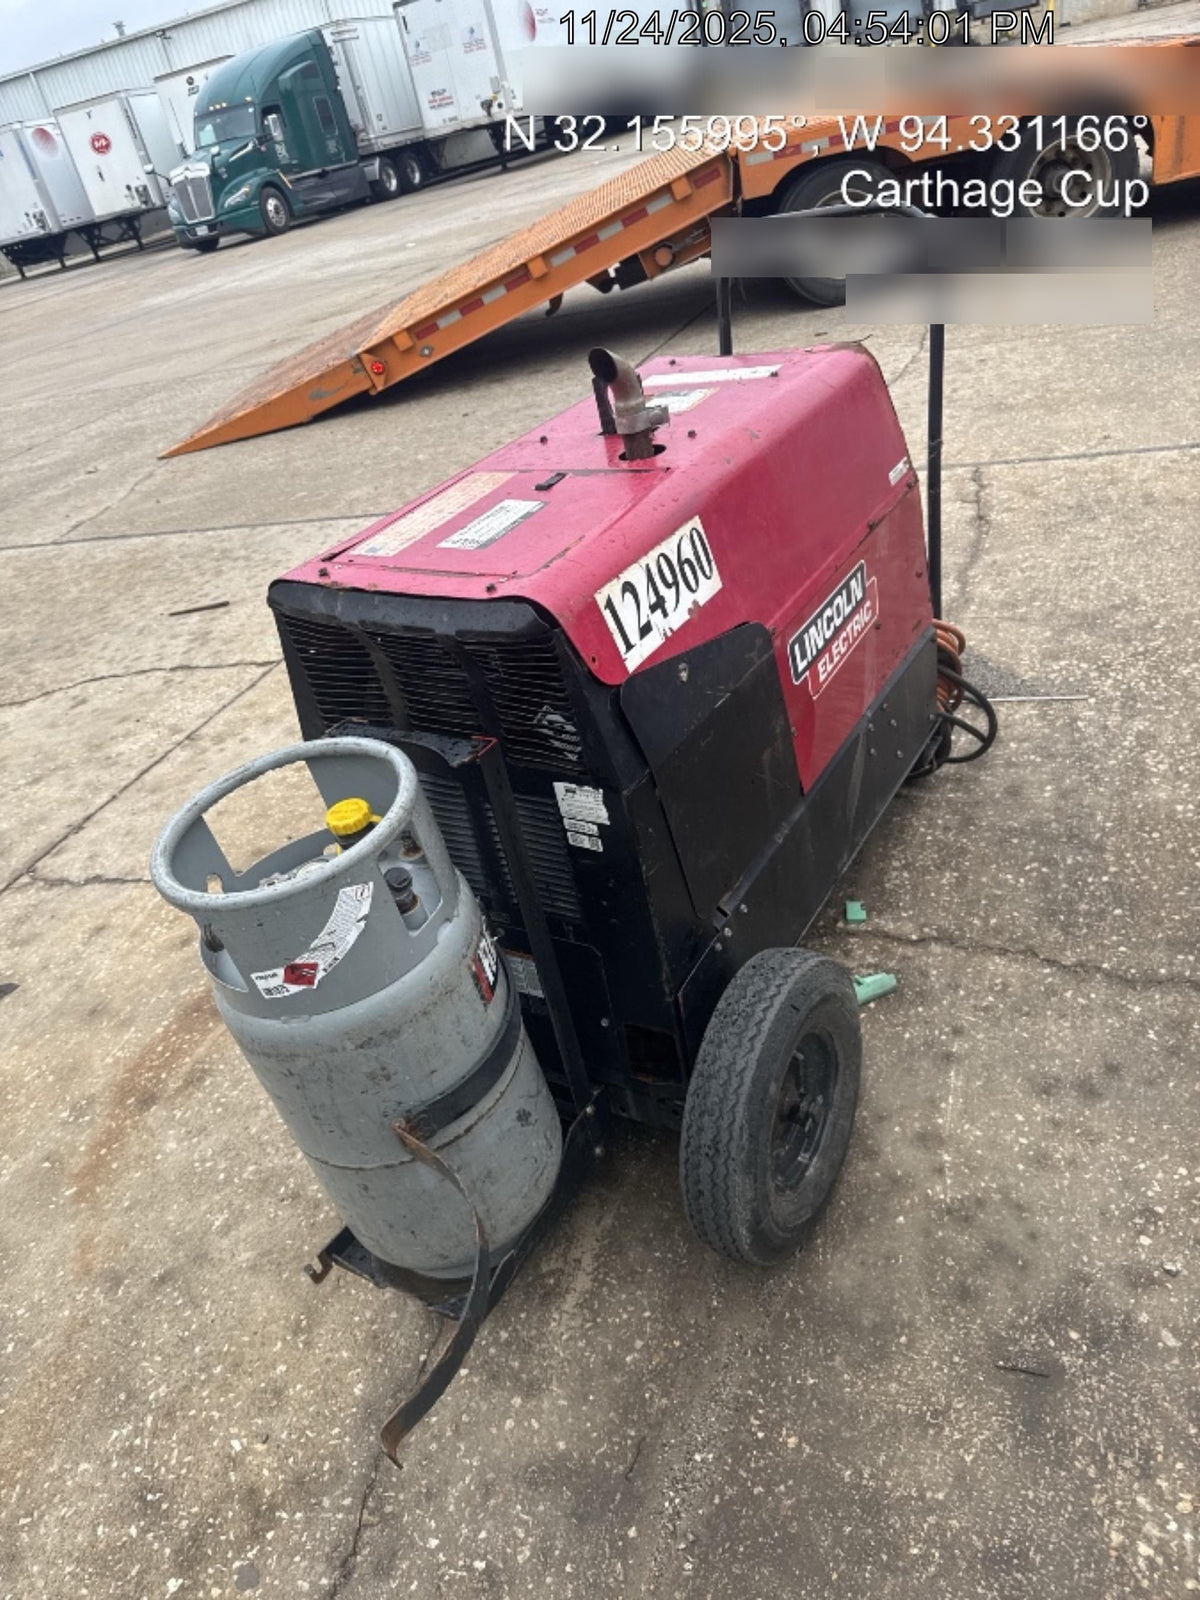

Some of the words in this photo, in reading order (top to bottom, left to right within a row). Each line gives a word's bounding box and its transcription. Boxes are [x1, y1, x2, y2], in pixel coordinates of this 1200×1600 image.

[603, 526, 714, 655] 124960
[794, 570, 864, 674] LINCOLN
[817, 600, 872, 682] ELECTRIC
